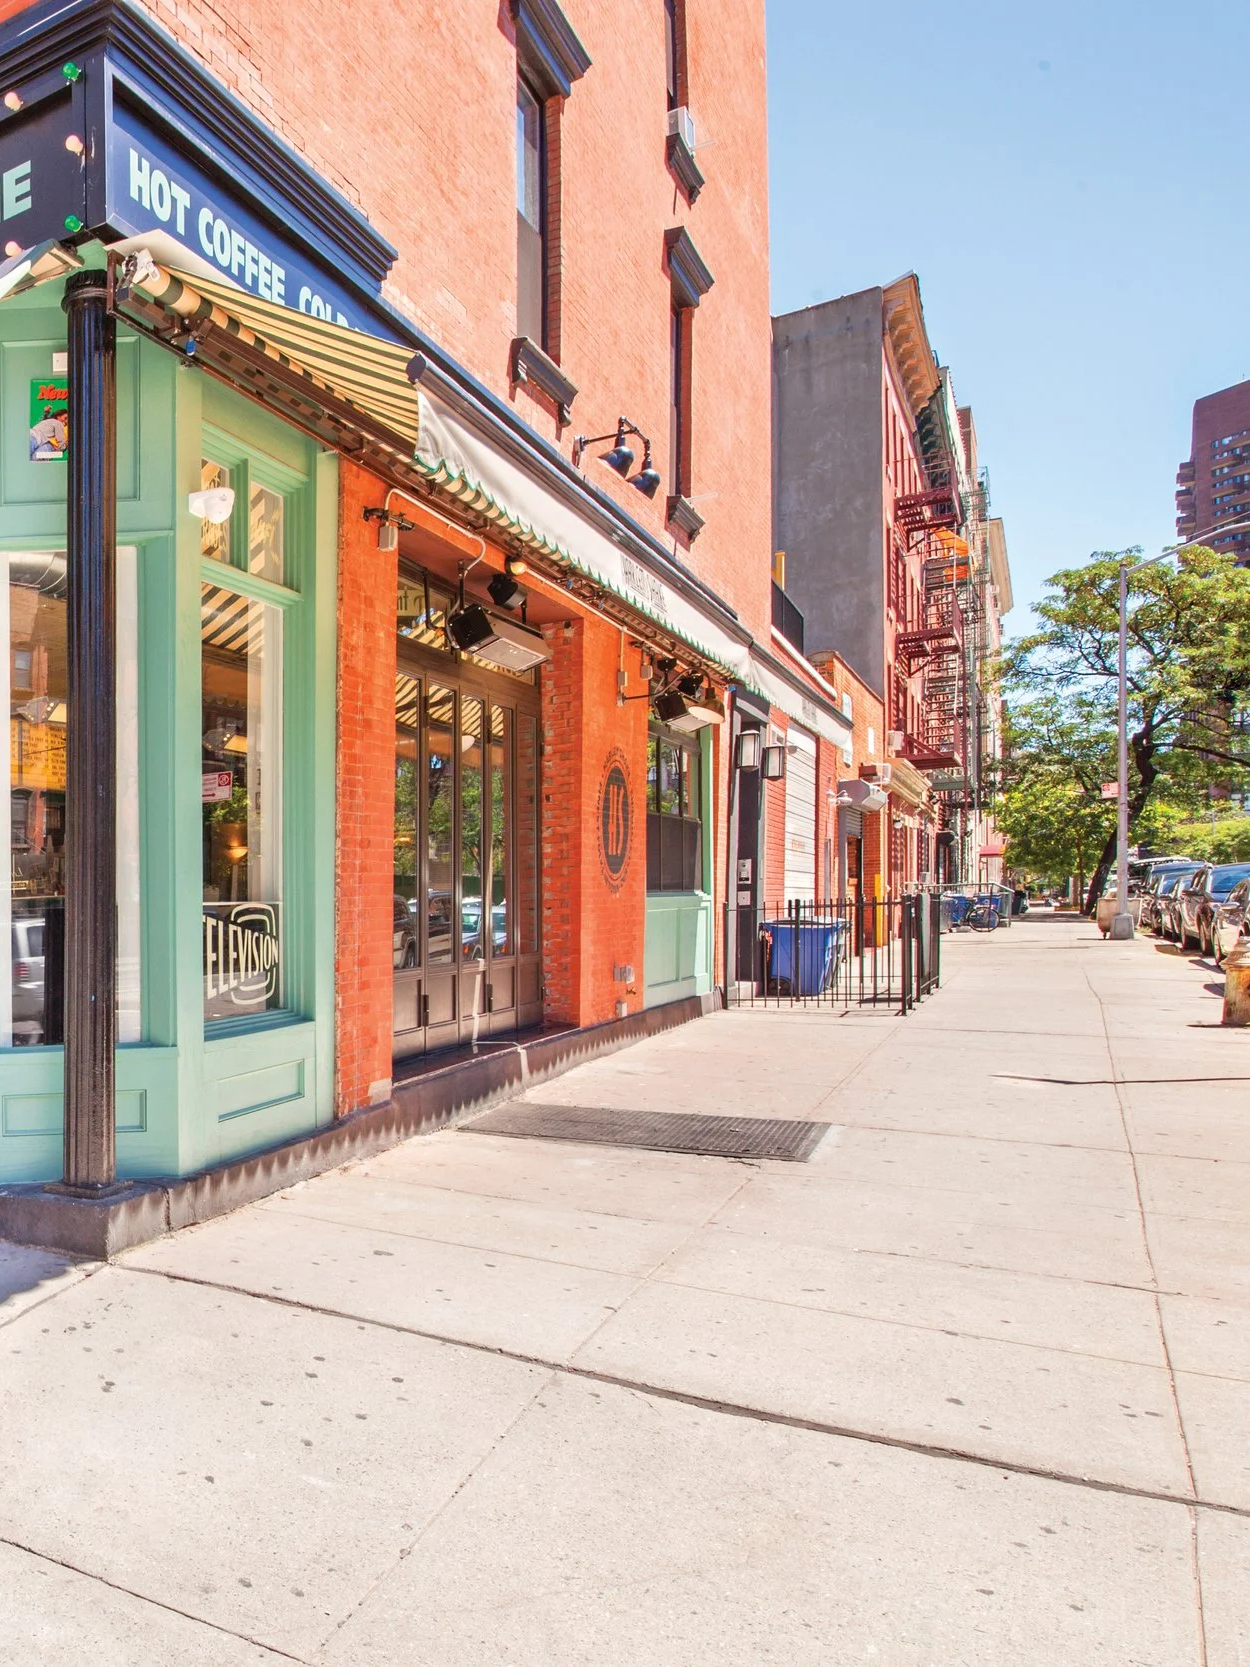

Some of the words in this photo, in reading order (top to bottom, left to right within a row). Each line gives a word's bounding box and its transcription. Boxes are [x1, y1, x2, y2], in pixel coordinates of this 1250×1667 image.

[129, 147, 191, 236] HOT
[198, 207, 286, 307] COFFEE
[203, 915, 279, 1000] ELEVISION
